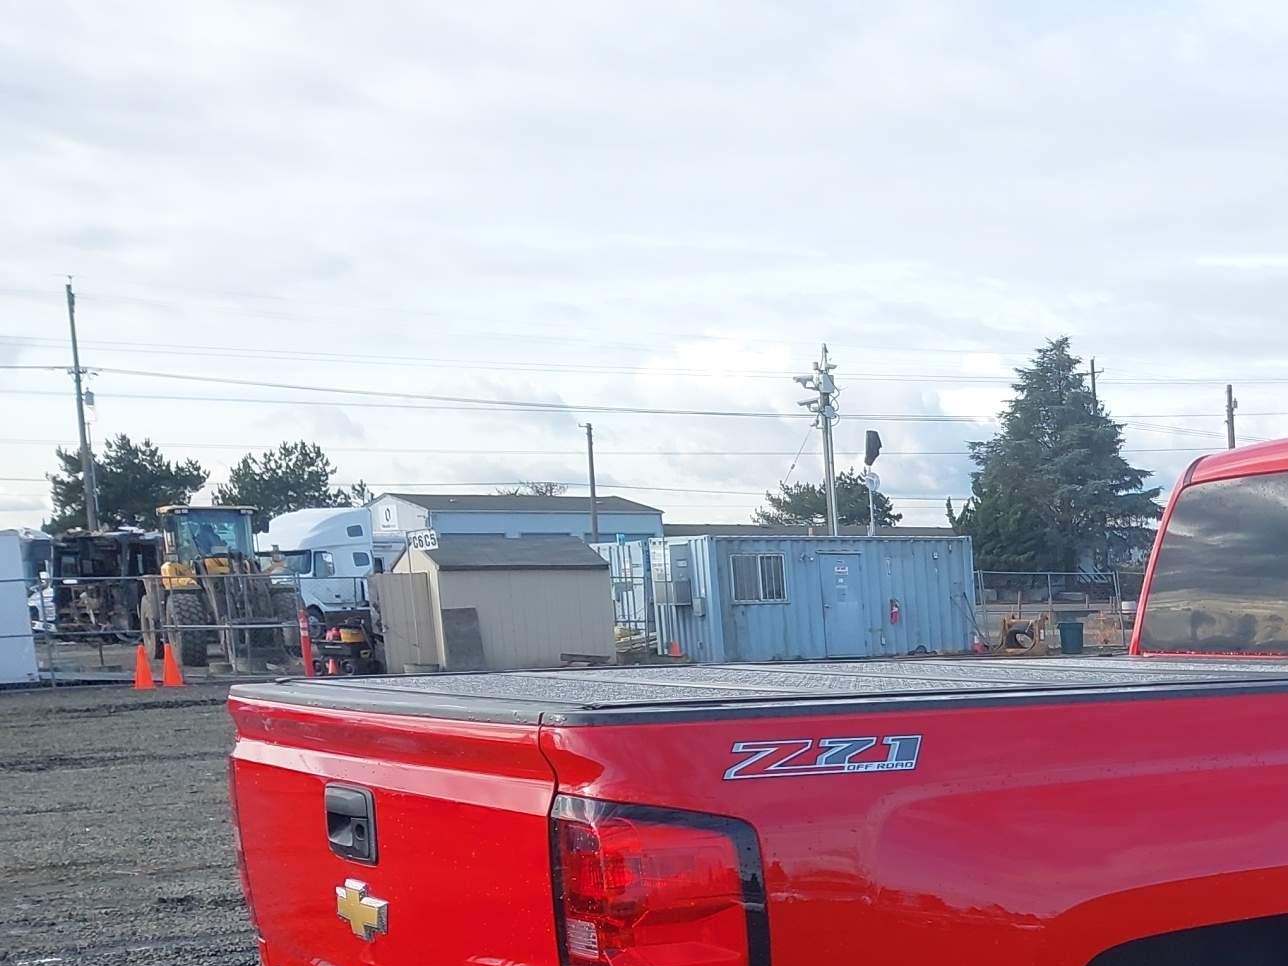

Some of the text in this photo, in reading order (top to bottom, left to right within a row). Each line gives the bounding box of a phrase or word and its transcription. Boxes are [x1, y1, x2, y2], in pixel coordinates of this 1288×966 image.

[722, 734, 922, 781] Z71
[846, 761, 914, 772] OFF ROAD
